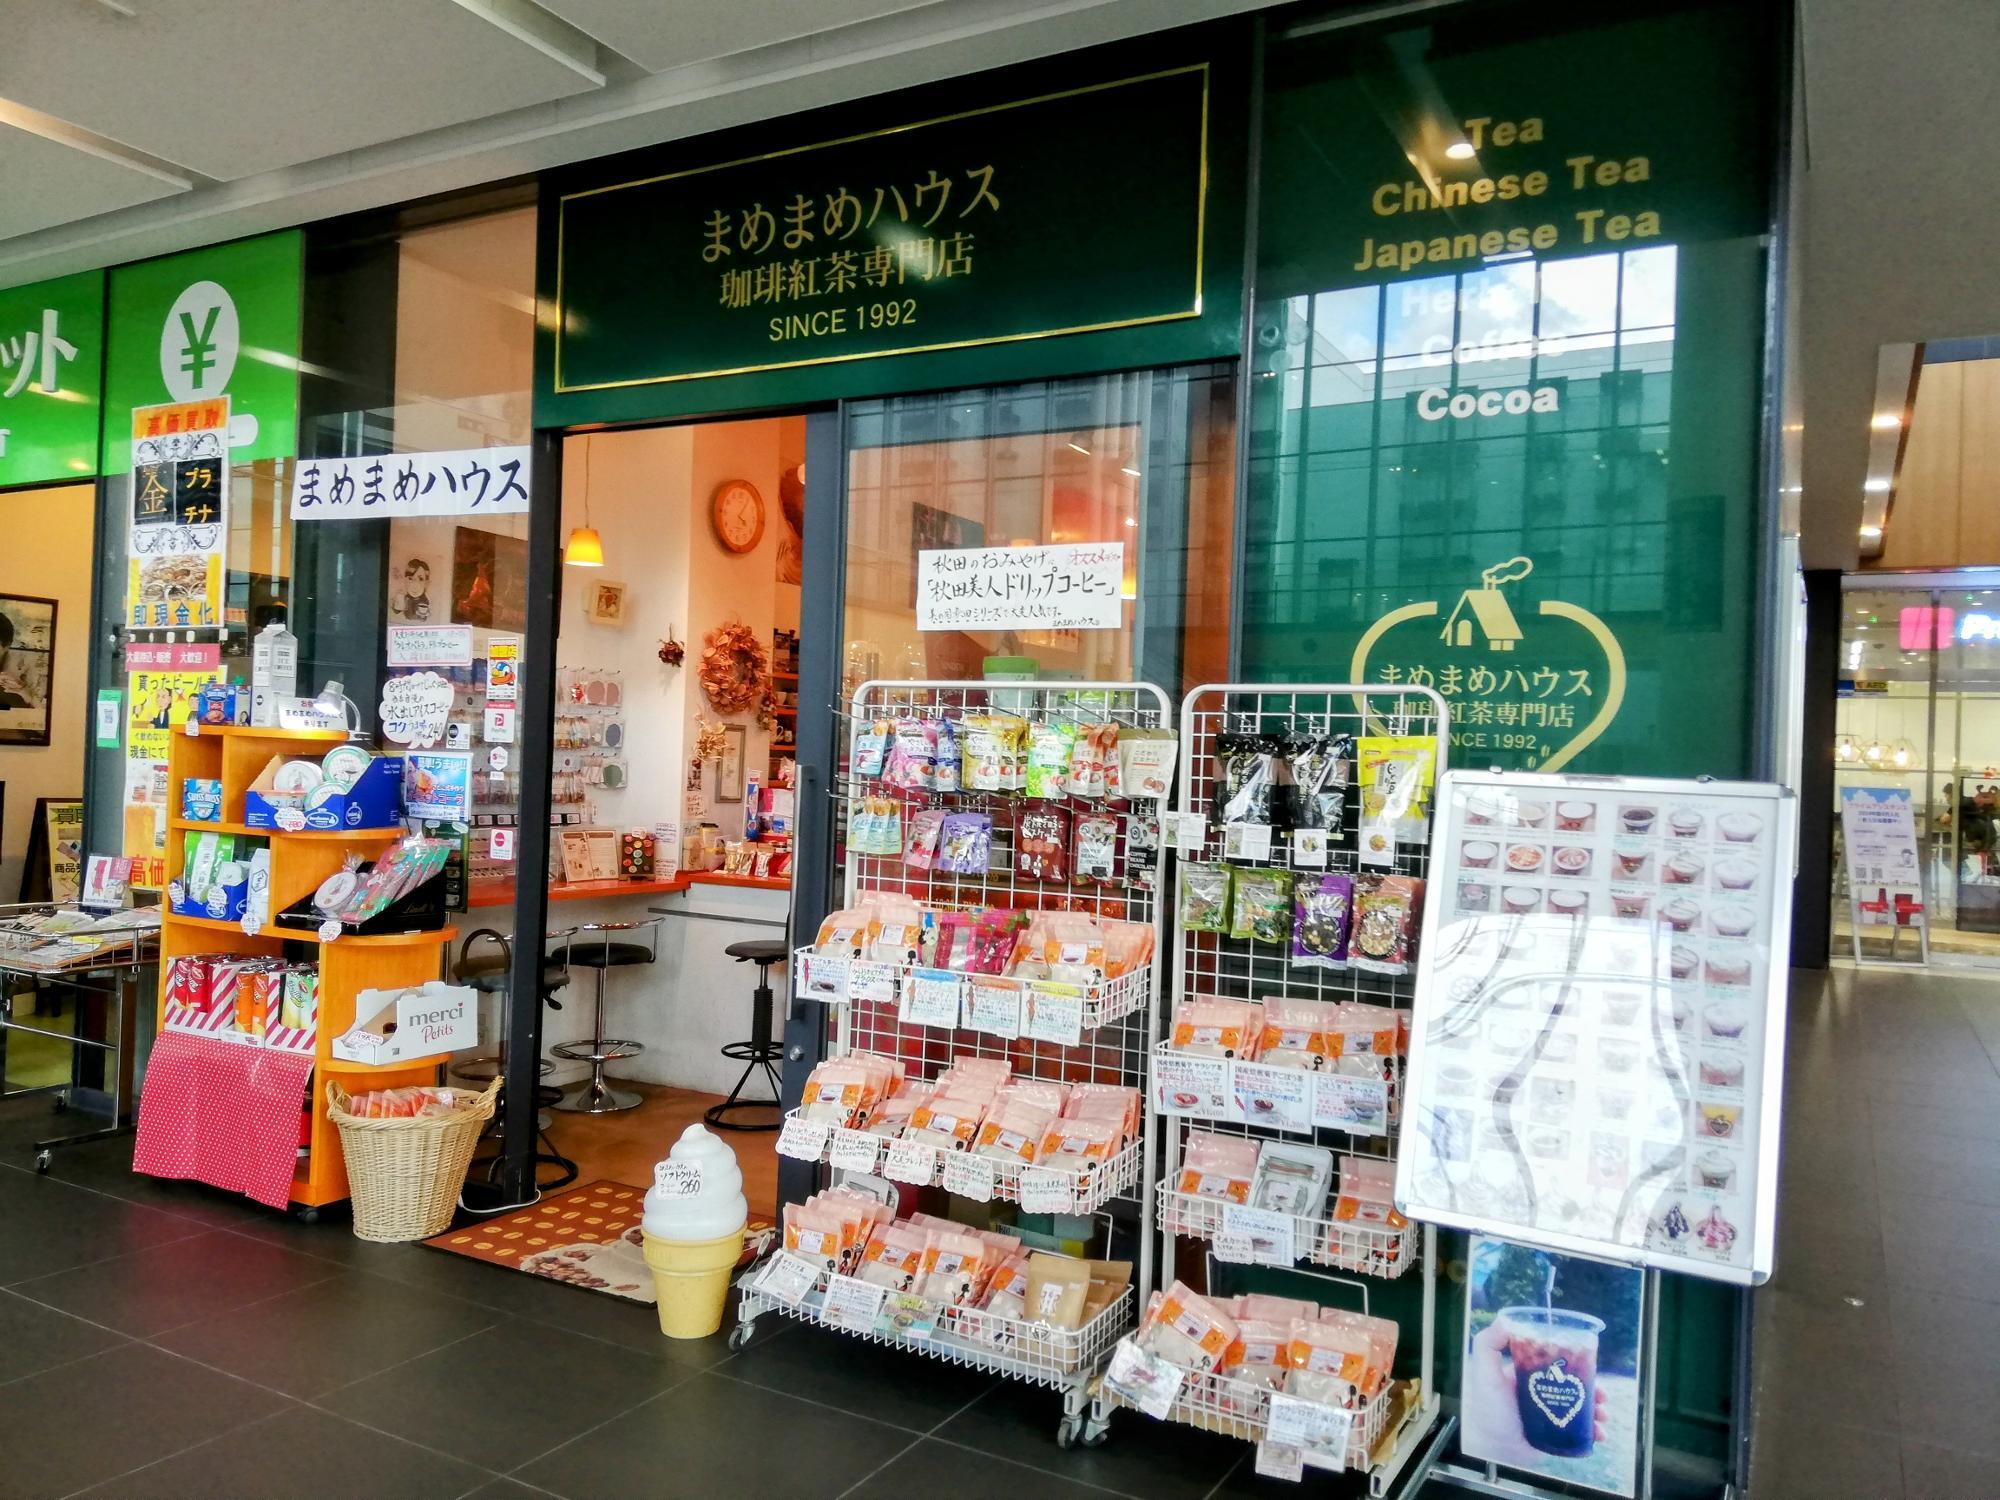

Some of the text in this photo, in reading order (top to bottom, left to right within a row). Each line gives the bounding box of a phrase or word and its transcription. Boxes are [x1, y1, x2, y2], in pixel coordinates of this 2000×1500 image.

[1465, 117, 1544, 150] Tea
[1372, 156, 1651, 216] Chinese Tea
[702, 164, 1001, 263] まめまめハウス
[1354, 210, 1661, 272] Japanese Tea
[719, 231, 975, 309] 珈琲紅茶専門店
[768, 299, 916, 341] SINCE 1992
[1417, 386, 1559, 421] Cocoa
[300, 459, 528, 508] まめまめハウス
[130, 746, 169, 759] 現金にて
[1494, 735, 1537, 750] 1992
[57, 808, 84, 825] 買
[408, 1002, 463, 1027] merci
[421, 1024, 454, 1043] Petits
